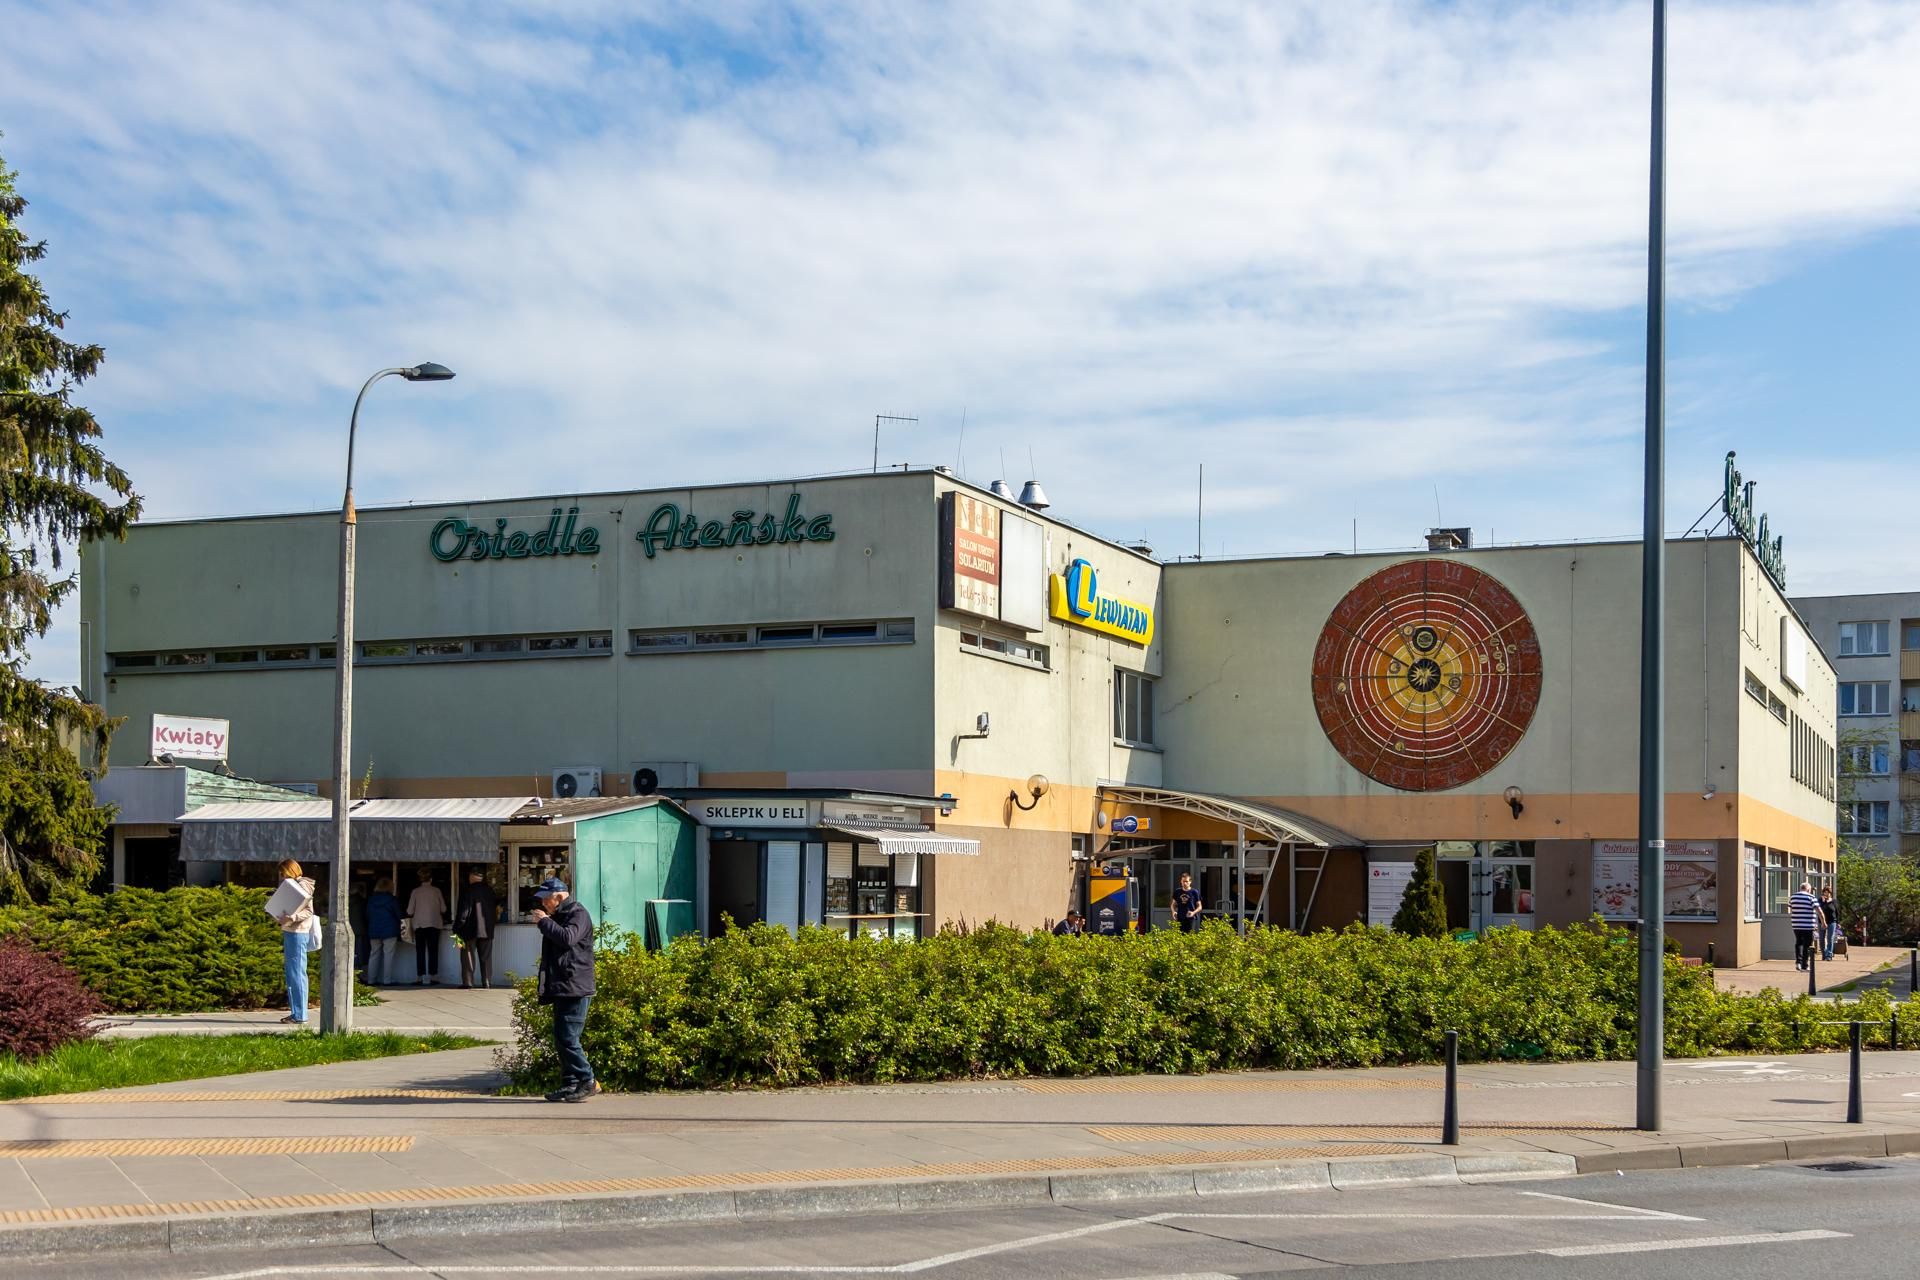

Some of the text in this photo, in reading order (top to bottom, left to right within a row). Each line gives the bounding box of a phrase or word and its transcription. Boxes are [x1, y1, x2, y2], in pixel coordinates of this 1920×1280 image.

[429, 507, 600, 561] Osiedle
[959, 537, 978, 552] SALON
[958, 552, 995, 576] SOLARIUM
[1095, 596, 1148, 635] LEWIATAN
[155, 726, 225, 749] Kwiaty
[706, 807, 805, 819] SKLEPIK U ELI
[1602, 843, 1639, 853] Cukierni
[1664, 863, 1681, 871] ODY
